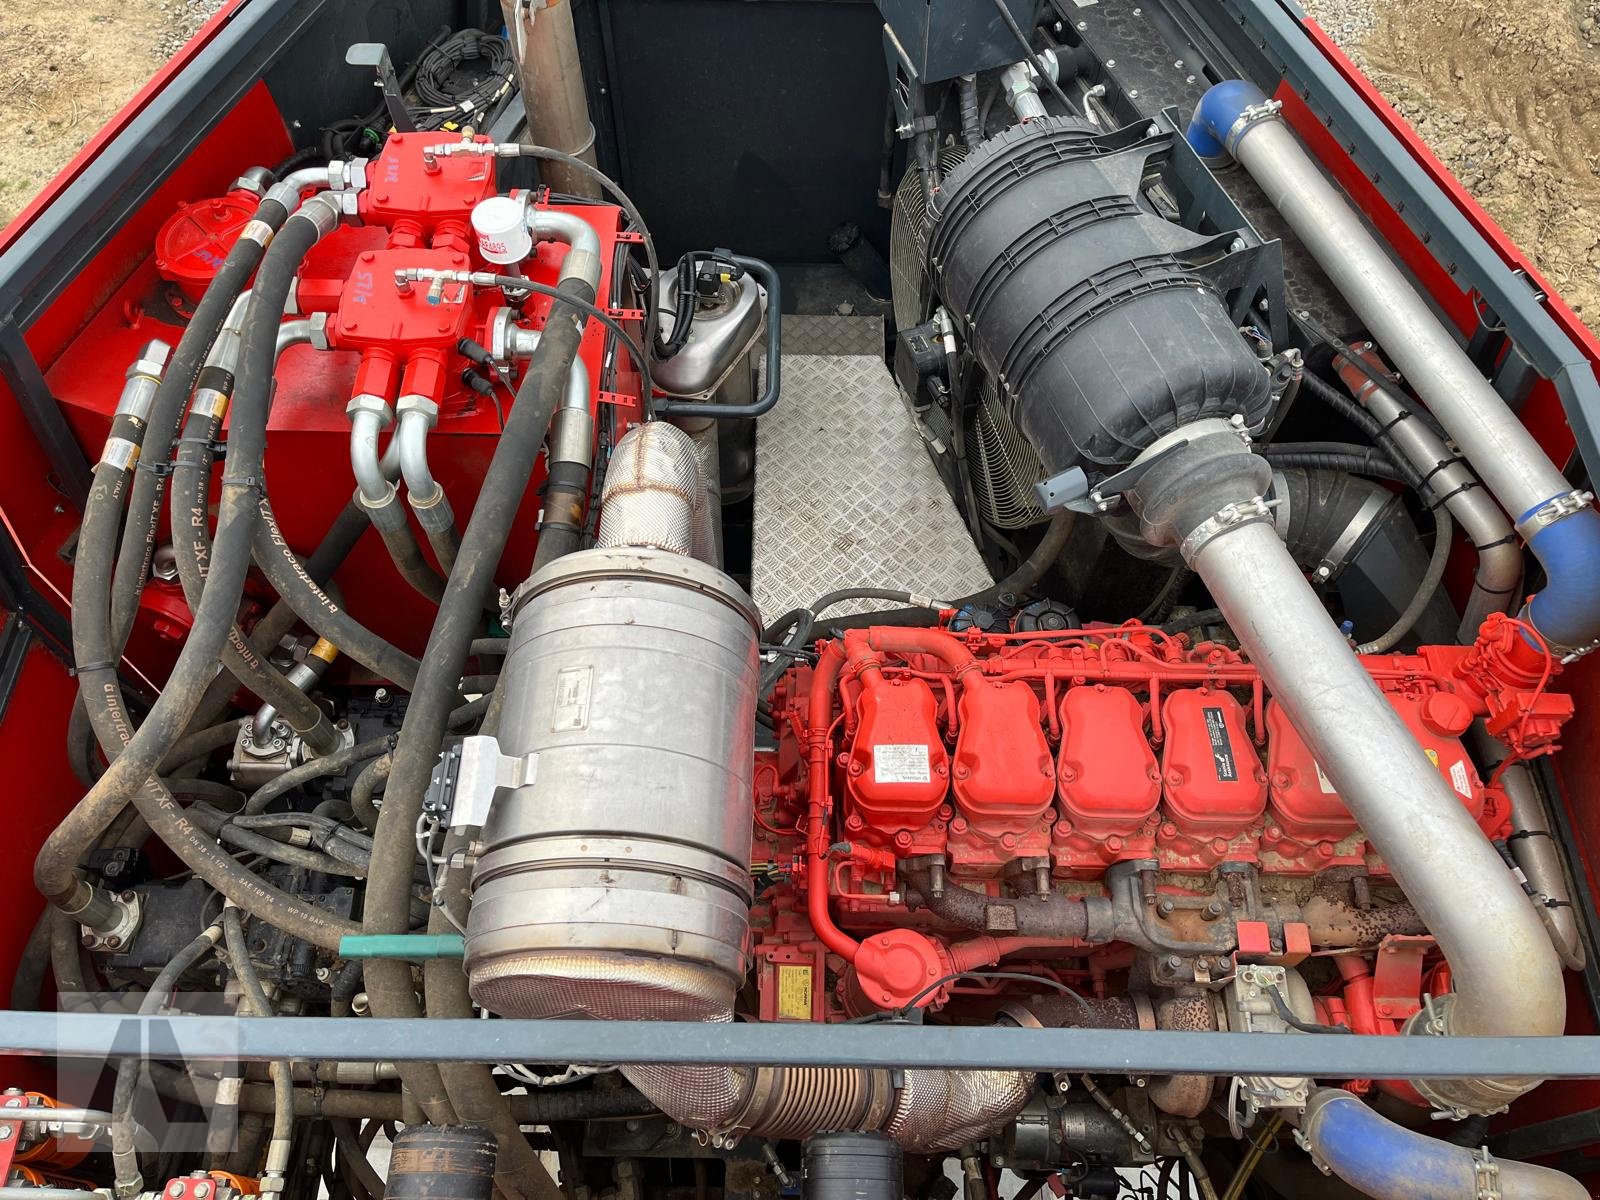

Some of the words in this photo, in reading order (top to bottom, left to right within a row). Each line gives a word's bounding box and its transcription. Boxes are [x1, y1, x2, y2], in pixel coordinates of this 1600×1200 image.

[113, 480, 123, 500] ITALY
[146, 514, 156, 542] FlexIT
[152, 500, 160, 512] XF
[156, 477, 165, 490] R4
[190, 506, 203, 526] R4
[260, 508, 285, 546] FlexIT
[193, 540, 208, 561] XF
[283, 549, 330, 606] intertraco
[155, 794, 174, 810] XF
[175, 817, 193, 835] R4
[239, 878, 252, 890] SAE
[287, 906, 299, 915] WP
